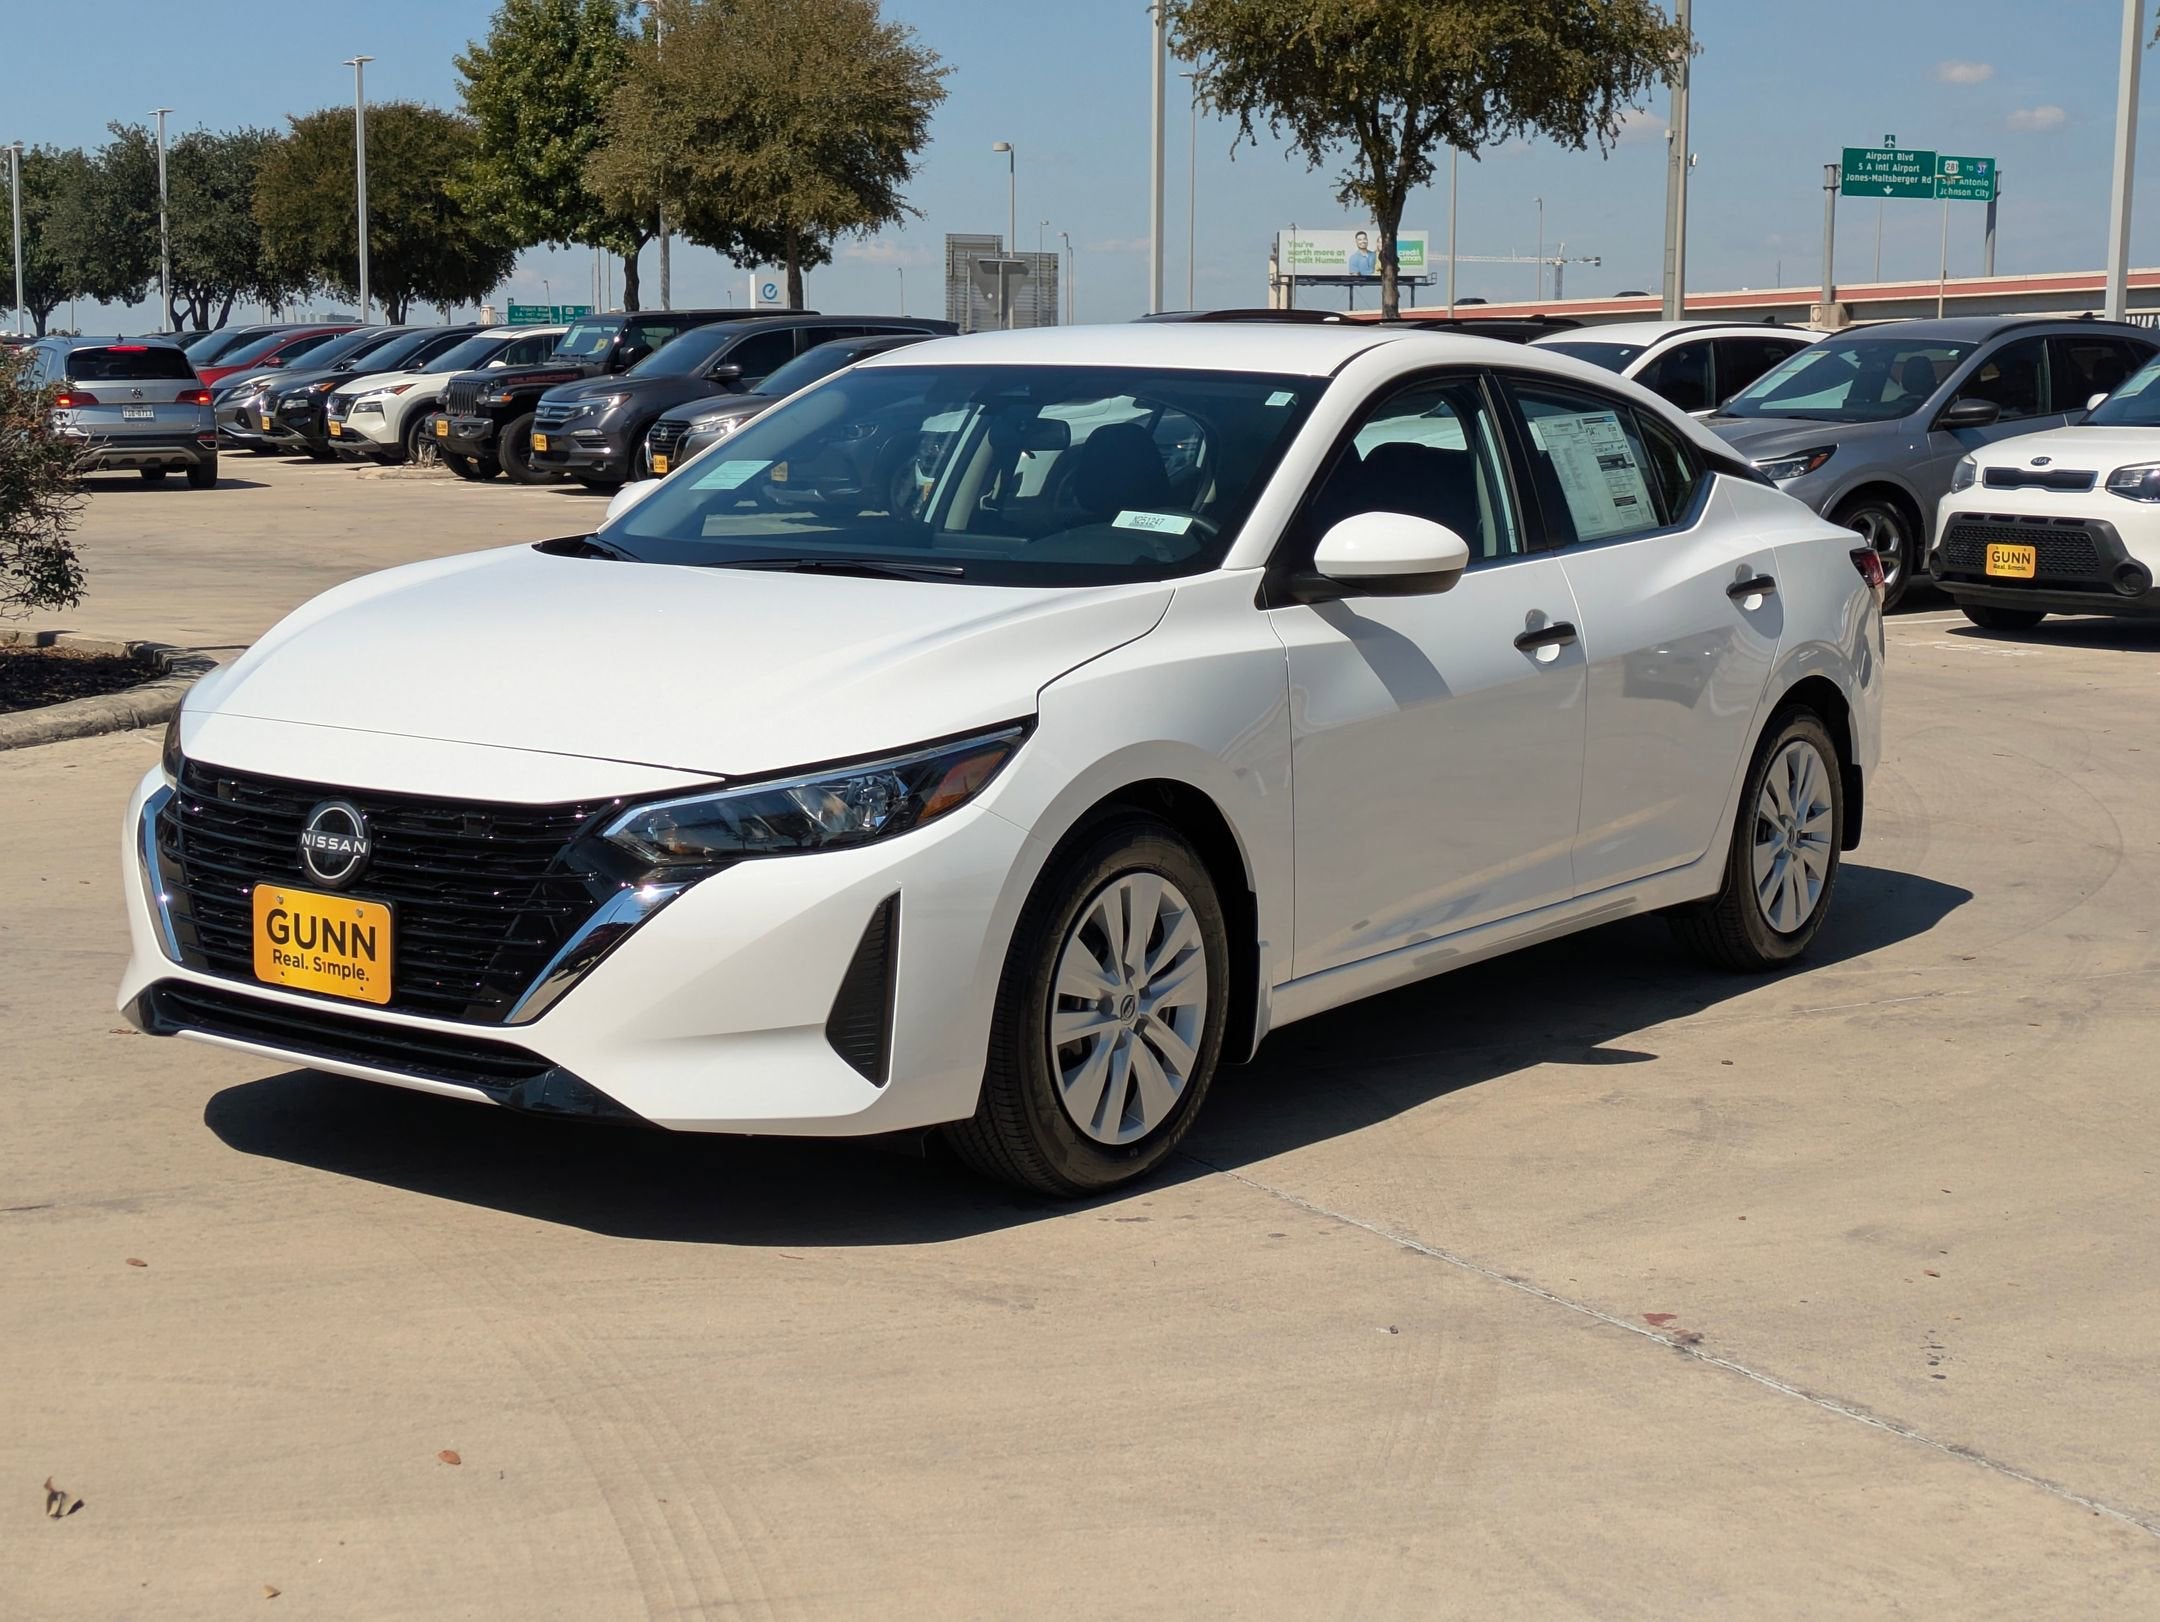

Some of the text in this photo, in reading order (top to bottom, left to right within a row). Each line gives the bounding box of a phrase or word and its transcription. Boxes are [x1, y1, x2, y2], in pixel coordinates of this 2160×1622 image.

[1865, 151, 1915, 162] Airport Blvd
[1866, 163, 1873, 171] A
[1892, 164, 1920, 174] Airport
[1946, 163, 1958, 171] 281
[1846, 173, 1932, 185] Jones-Maltsberger Rd
[1959, 177, 1989, 187] Antonio
[1974, 188, 1990, 199] City
[1287, 256, 1313, 264] Credit
[1992, 551, 2031, 564] GUNN
[301, 832, 367, 854] NISSAN
[266, 908, 376, 962] GUNN
[272, 948, 370, 982] Real. Simple.
